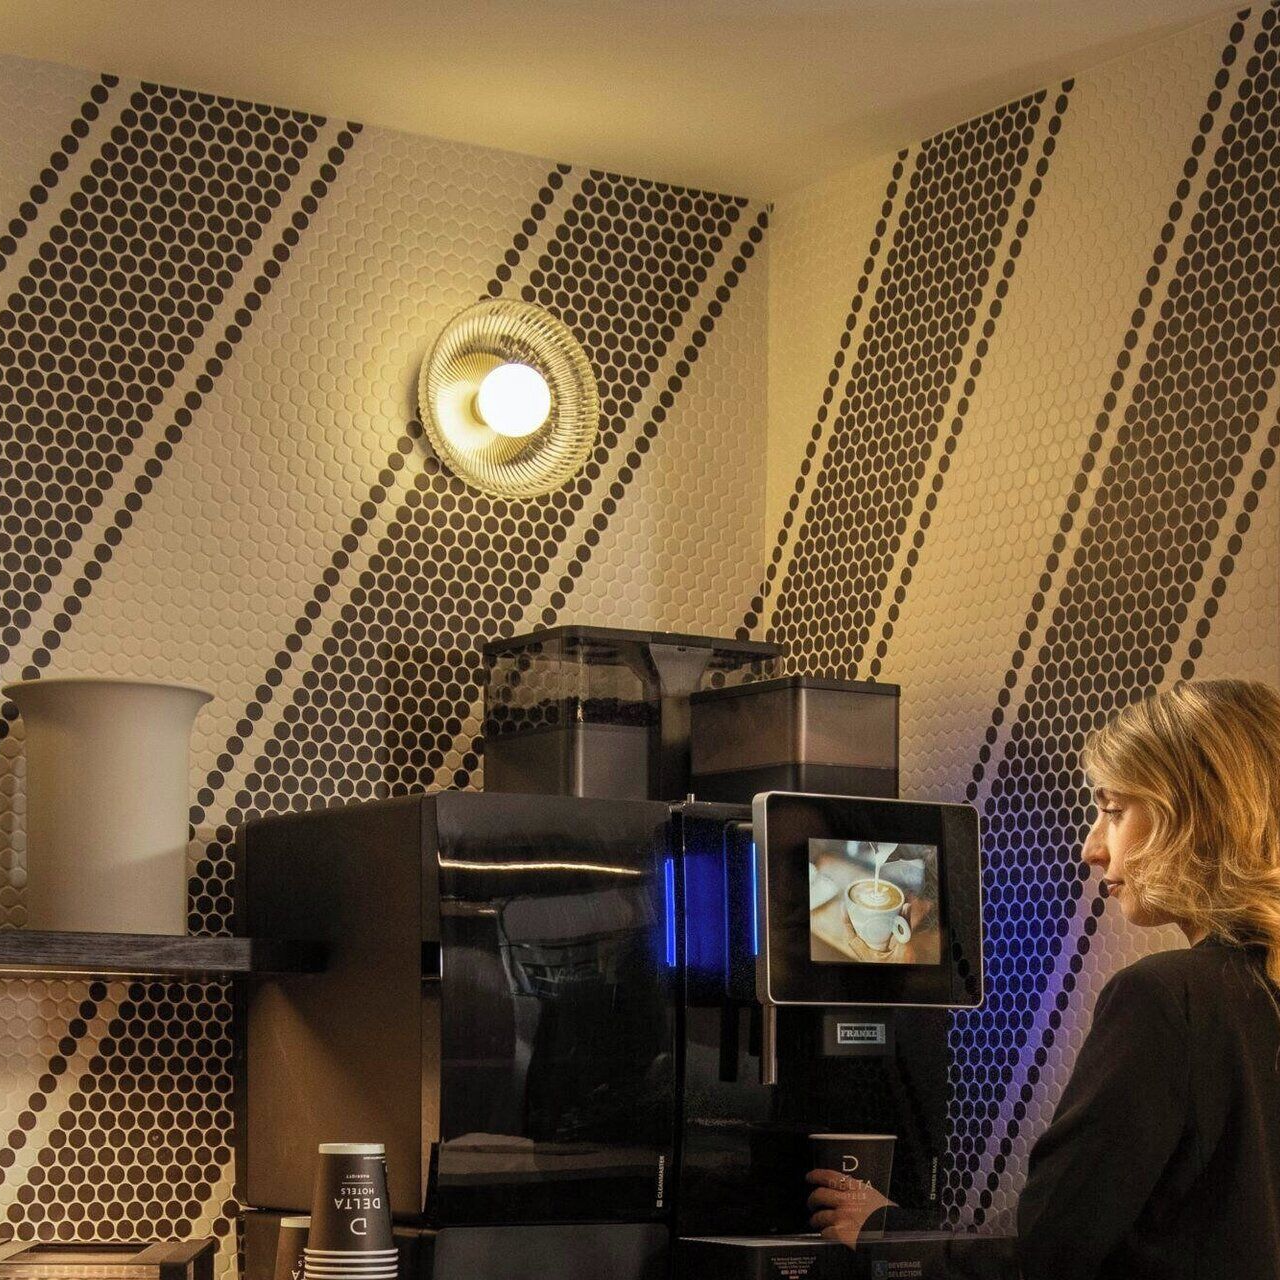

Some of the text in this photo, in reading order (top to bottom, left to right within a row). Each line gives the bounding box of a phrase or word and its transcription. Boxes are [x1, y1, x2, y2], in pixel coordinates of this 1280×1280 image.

[842, 1155, 859, 1172] D
[340, 1187, 375, 1195] HOTELS
[334, 1198, 381, 1210] DELTA
[350, 1218, 367, 1235] D
